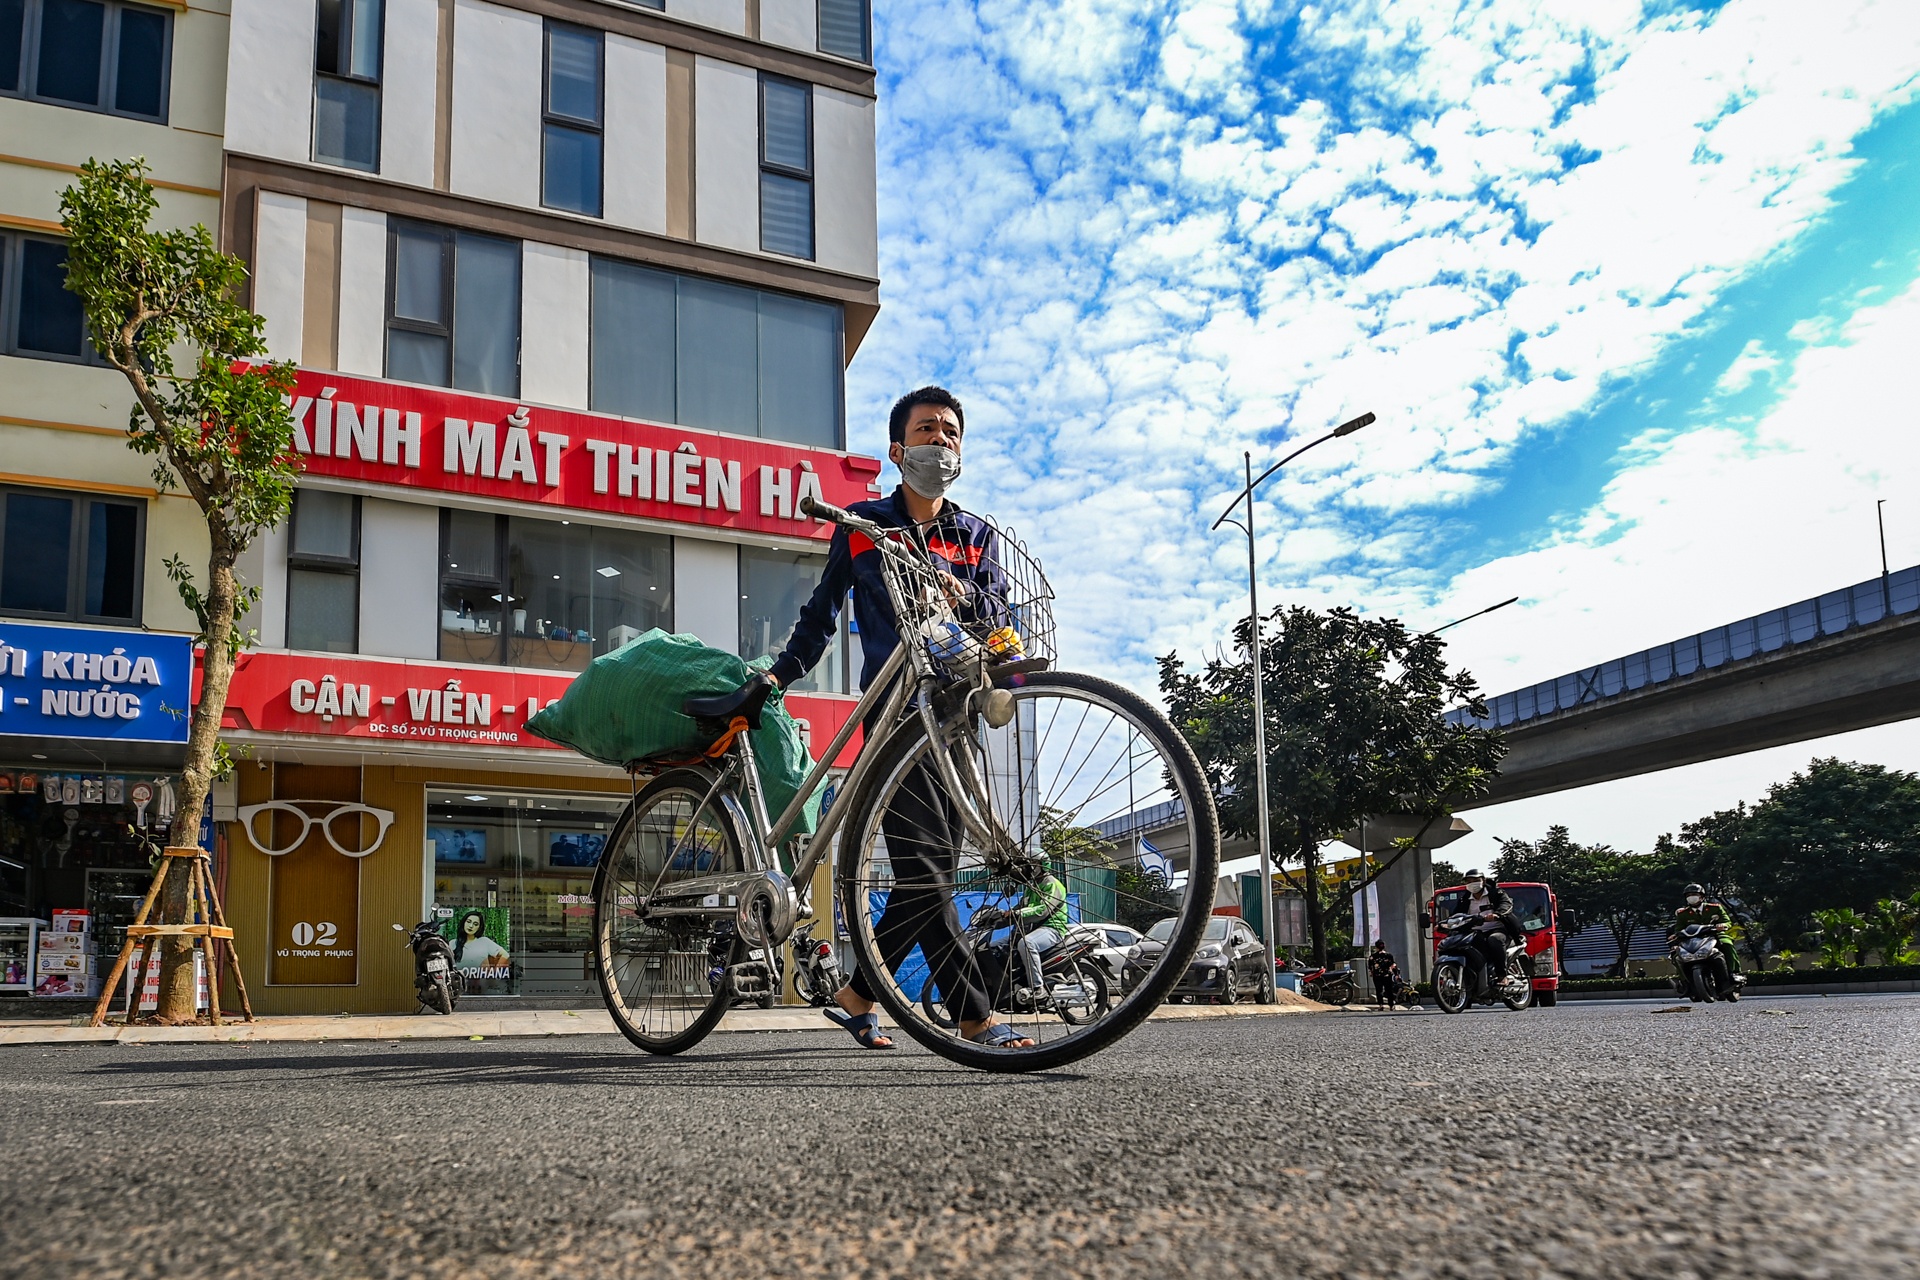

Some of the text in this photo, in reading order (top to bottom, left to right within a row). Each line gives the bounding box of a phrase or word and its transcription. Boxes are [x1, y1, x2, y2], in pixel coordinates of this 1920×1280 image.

[280, 386, 829, 524] KÍNH MẮT THIÊN HÀ
[42, 647, 161, 686] KHÓA
[41, 684, 141, 720] NƯỚC
[290, 674, 370, 722] CẬN
[407, 678, 491, 726] VIỄN
[369, 721, 518, 743] ĐC: SỐ 2 VŨ TRỌNG PHỤNG
[291, 921, 338, 946] 02
[276, 948, 354, 959] VŨ TRỌNG PHỤNG
